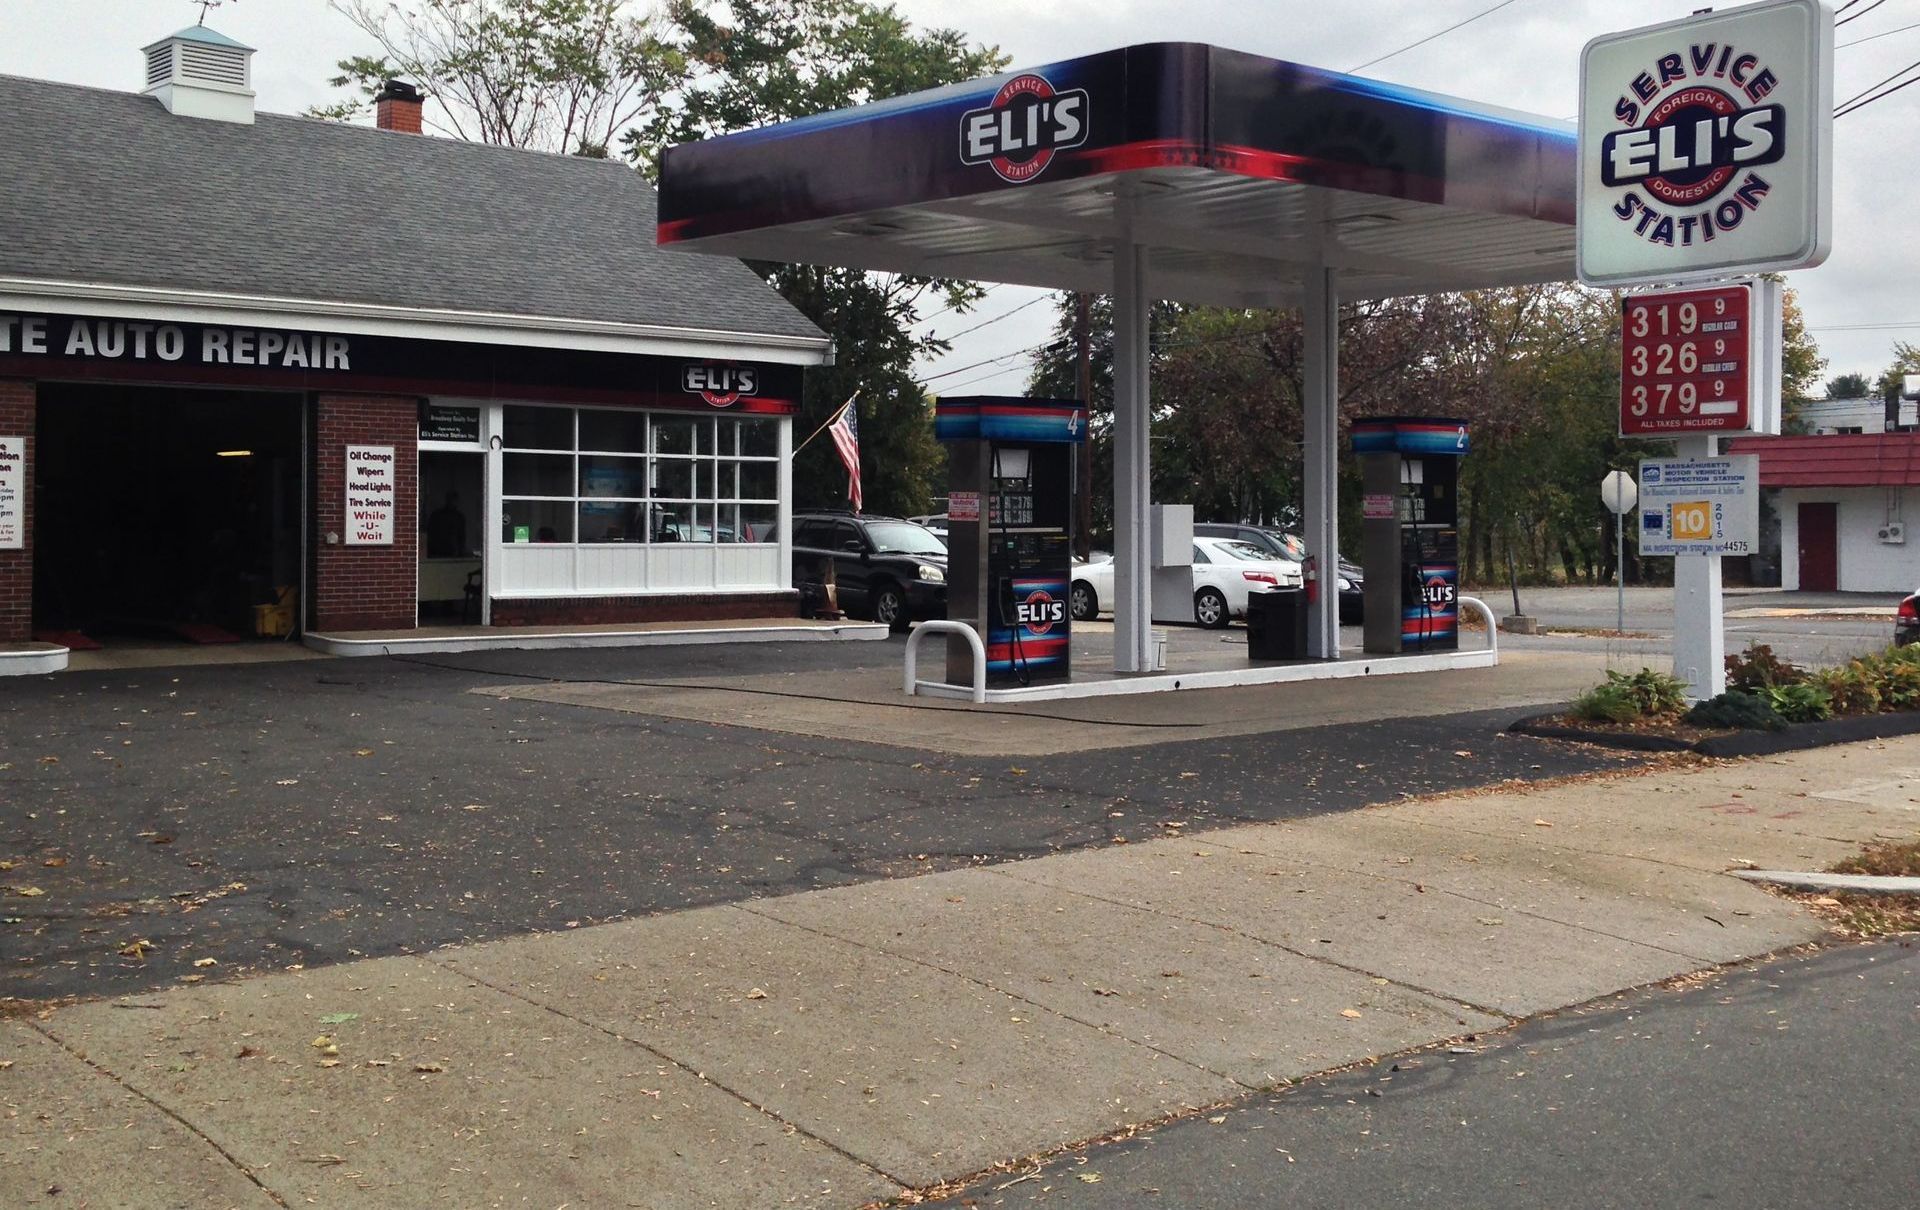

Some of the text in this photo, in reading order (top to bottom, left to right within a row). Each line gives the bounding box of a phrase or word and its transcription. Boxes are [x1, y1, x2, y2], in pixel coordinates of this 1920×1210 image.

[1003, 80, 1042, 98] SERVICE
[1614, 42, 1779, 126] SERVICE
[1654, 92, 1726, 122] FOREIGN &
[968, 96, 1081, 157] ELI'S
[1610, 109, 1774, 179] ELI'S
[1006, 160, 1040, 176] STATION
[1653, 171, 1723, 199] DOMESTIC
[1612, 170, 1771, 247] STATION
[1714, 298, 1726, 315] 9
[64, 319, 185, 361] AUTO
[202, 328, 351, 371] REPAIR
[1631, 339, 1726, 377] 326 9
[687, 367, 754, 392] ELI'S
[1631, 380, 1725, 417] 379 9
[1066, 409, 1079, 436] 4
[1683, 418, 1724, 426] INCLUDED
[1456, 426, 1465, 450] 2
[349, 451, 392, 463] Oil Change
[356, 467, 384, 478] Wipers
[349, 482, 392, 493] Head Lights
[349, 497, 392, 507] Tire Service
[354, 511, 386, 520] While
[1676, 509, 1705, 533] 10
[357, 532, 382, 540] Wait
[1723, 541, 1748, 552] 44575
[1017, 602, 1063, 623] ELI'S
